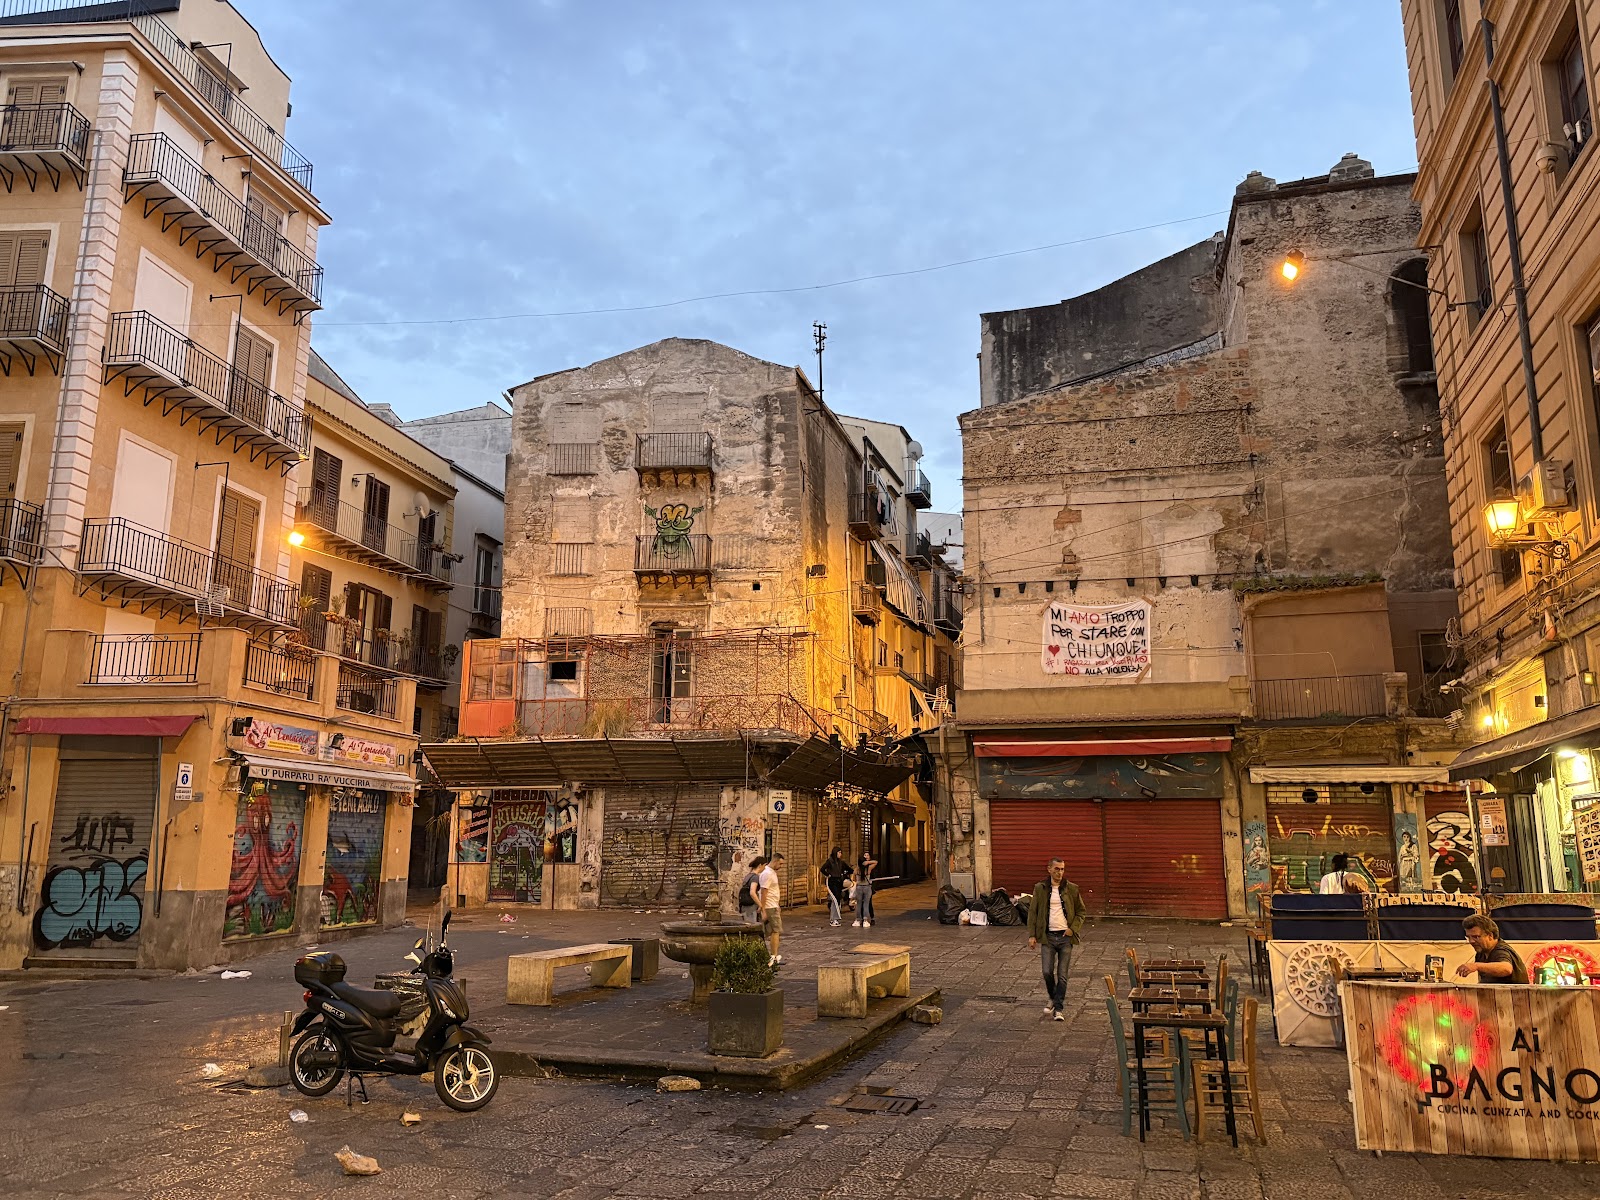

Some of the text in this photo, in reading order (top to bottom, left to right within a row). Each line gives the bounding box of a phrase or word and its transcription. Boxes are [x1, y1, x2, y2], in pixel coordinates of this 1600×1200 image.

[1051, 608, 1145, 625] MI AMO TROPPO
[1079, 625, 1128, 640] STARE
[1065, 666, 1079, 675] NO
[272, 769, 314, 781] PURPARU
[334, 776, 371, 788] VUCCIRIA
[1511, 1028, 1540, 1053] Ai
[1430, 1064, 1600, 1104] BAGNO
[1438, 1104, 1477, 1116] CUCINA
[1483, 1106, 1533, 1118] CUNZATA
[1539, 1109, 1561, 1119] AND
